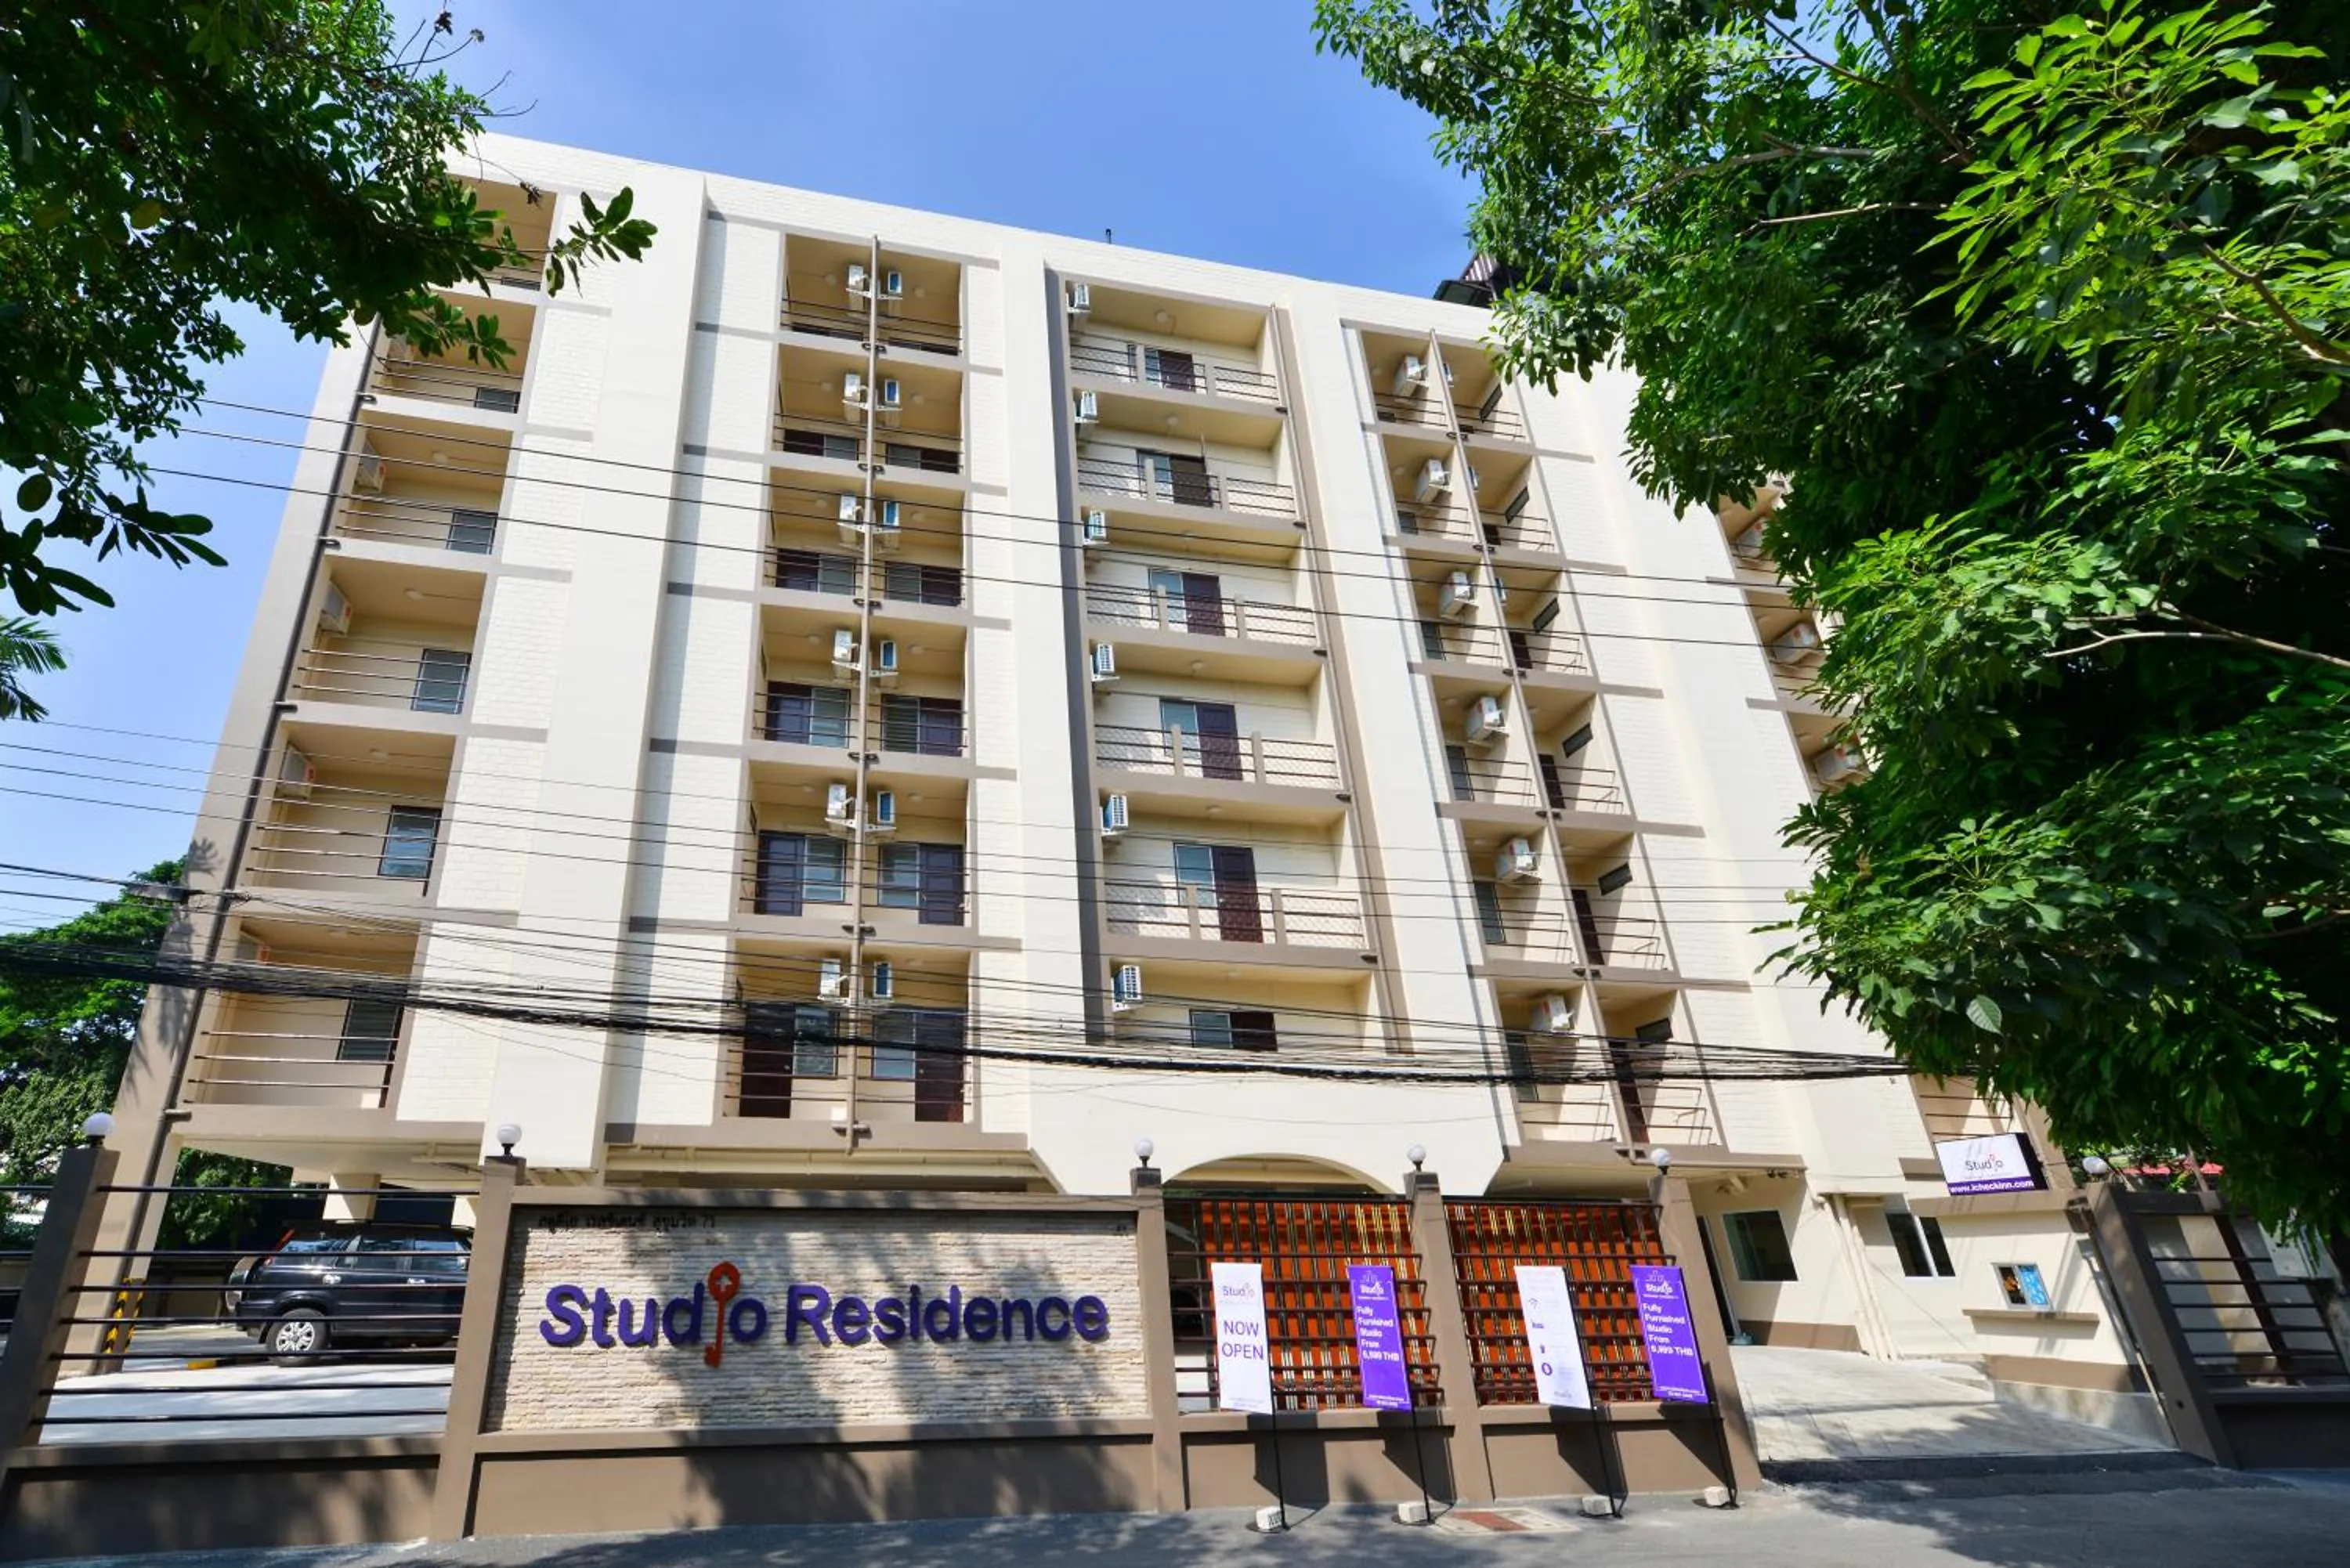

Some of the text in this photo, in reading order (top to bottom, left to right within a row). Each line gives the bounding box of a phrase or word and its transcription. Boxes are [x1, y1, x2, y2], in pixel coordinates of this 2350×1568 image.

[1357, 1306, 1374, 1317] Fully
[1642, 1302, 1662, 1314] Fully
[540, 1262, 1111, 1367] Studio Residence
[1644, 1313, 1686, 1325] Furnished
[1358, 1317, 1394, 1328] Furnished
[1223, 1320, 1260, 1339] NOW
[1361, 1339, 1379, 1349] From
[1648, 1334, 1670, 1344] From
[1221, 1342, 1264, 1361] OPEN
